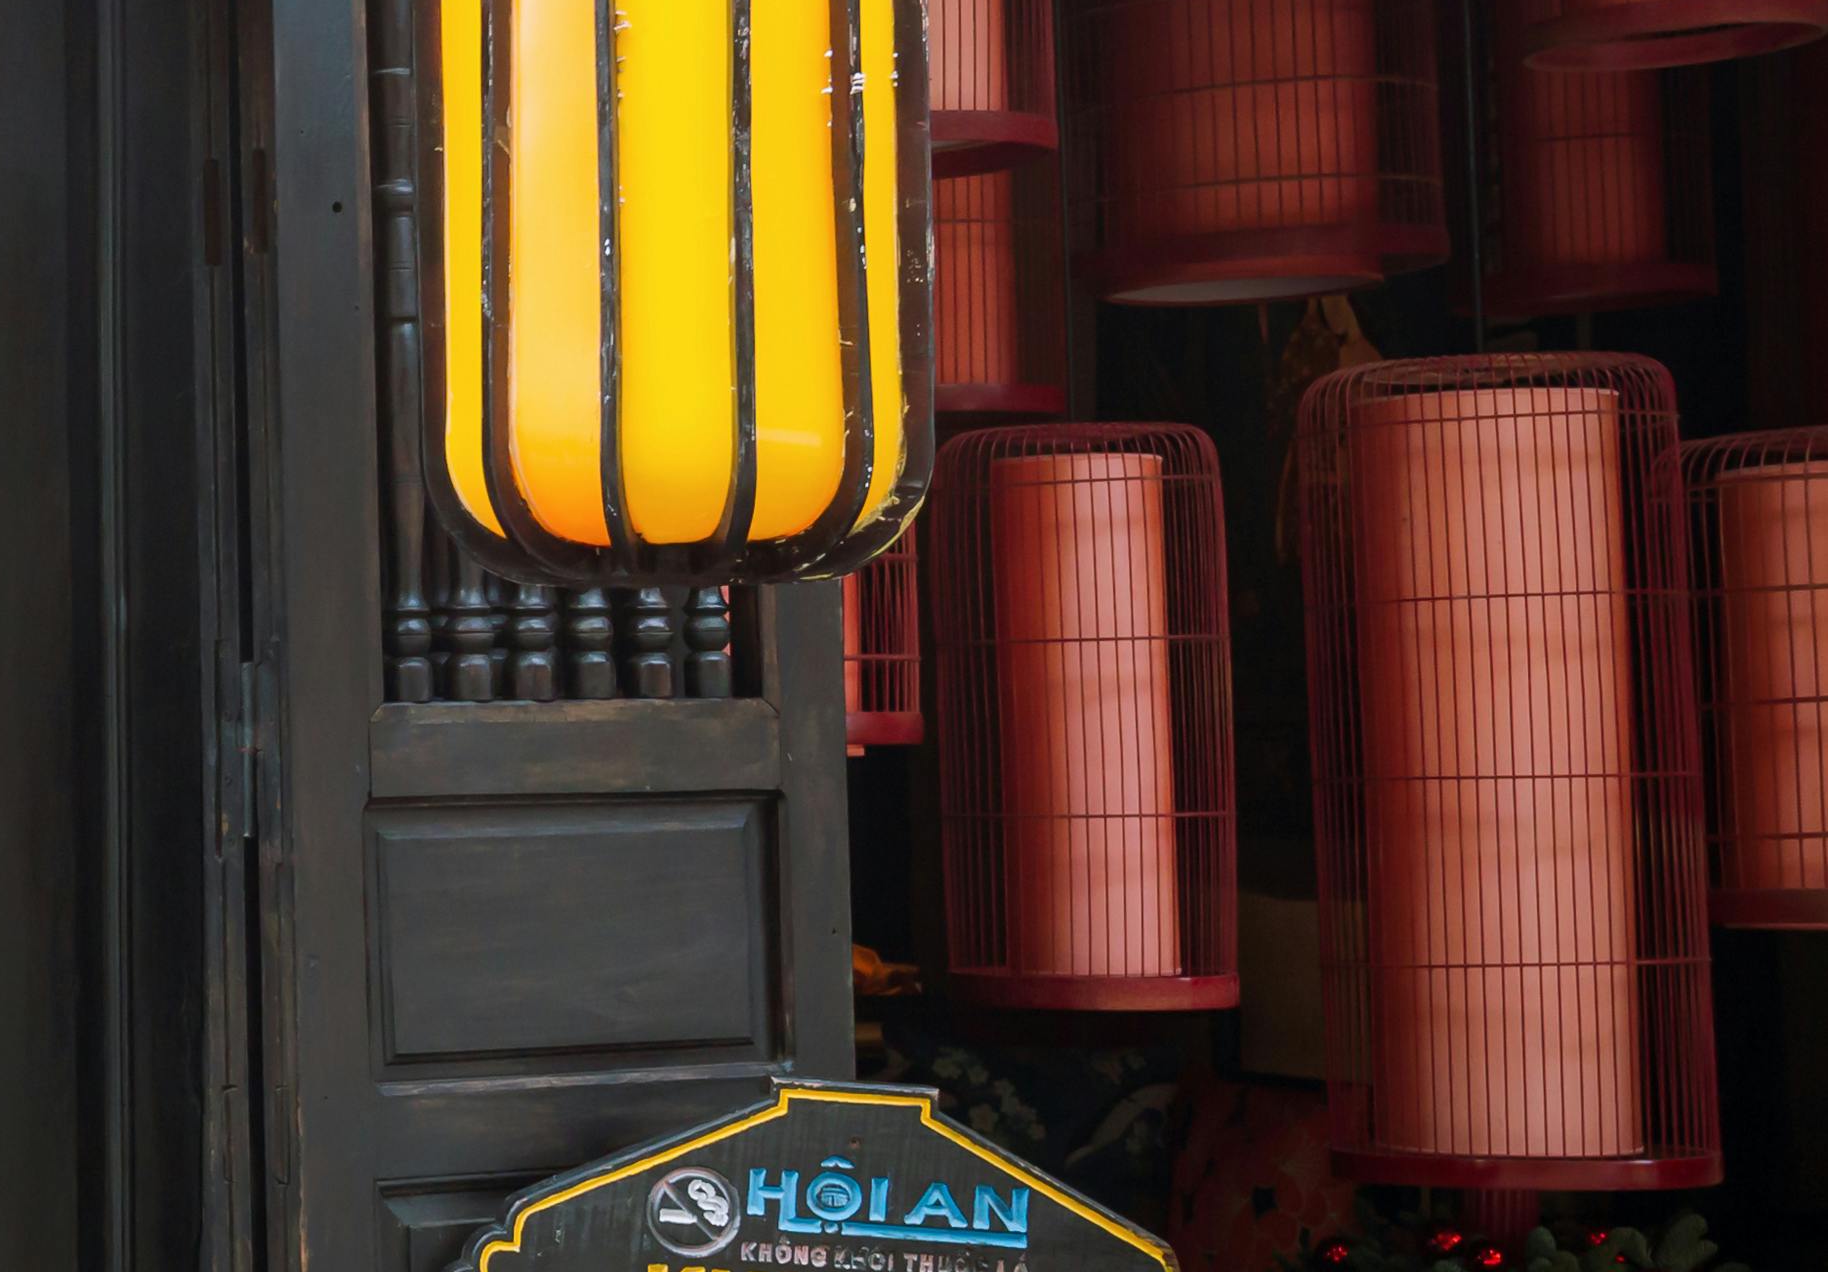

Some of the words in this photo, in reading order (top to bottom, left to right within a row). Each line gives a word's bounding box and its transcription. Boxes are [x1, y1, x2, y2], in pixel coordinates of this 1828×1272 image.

[746, 1154, 889, 1235] HỘI
[903, 1182, 1030, 1233] AN
[740, 1235, 828, 1268] KHÔNG
